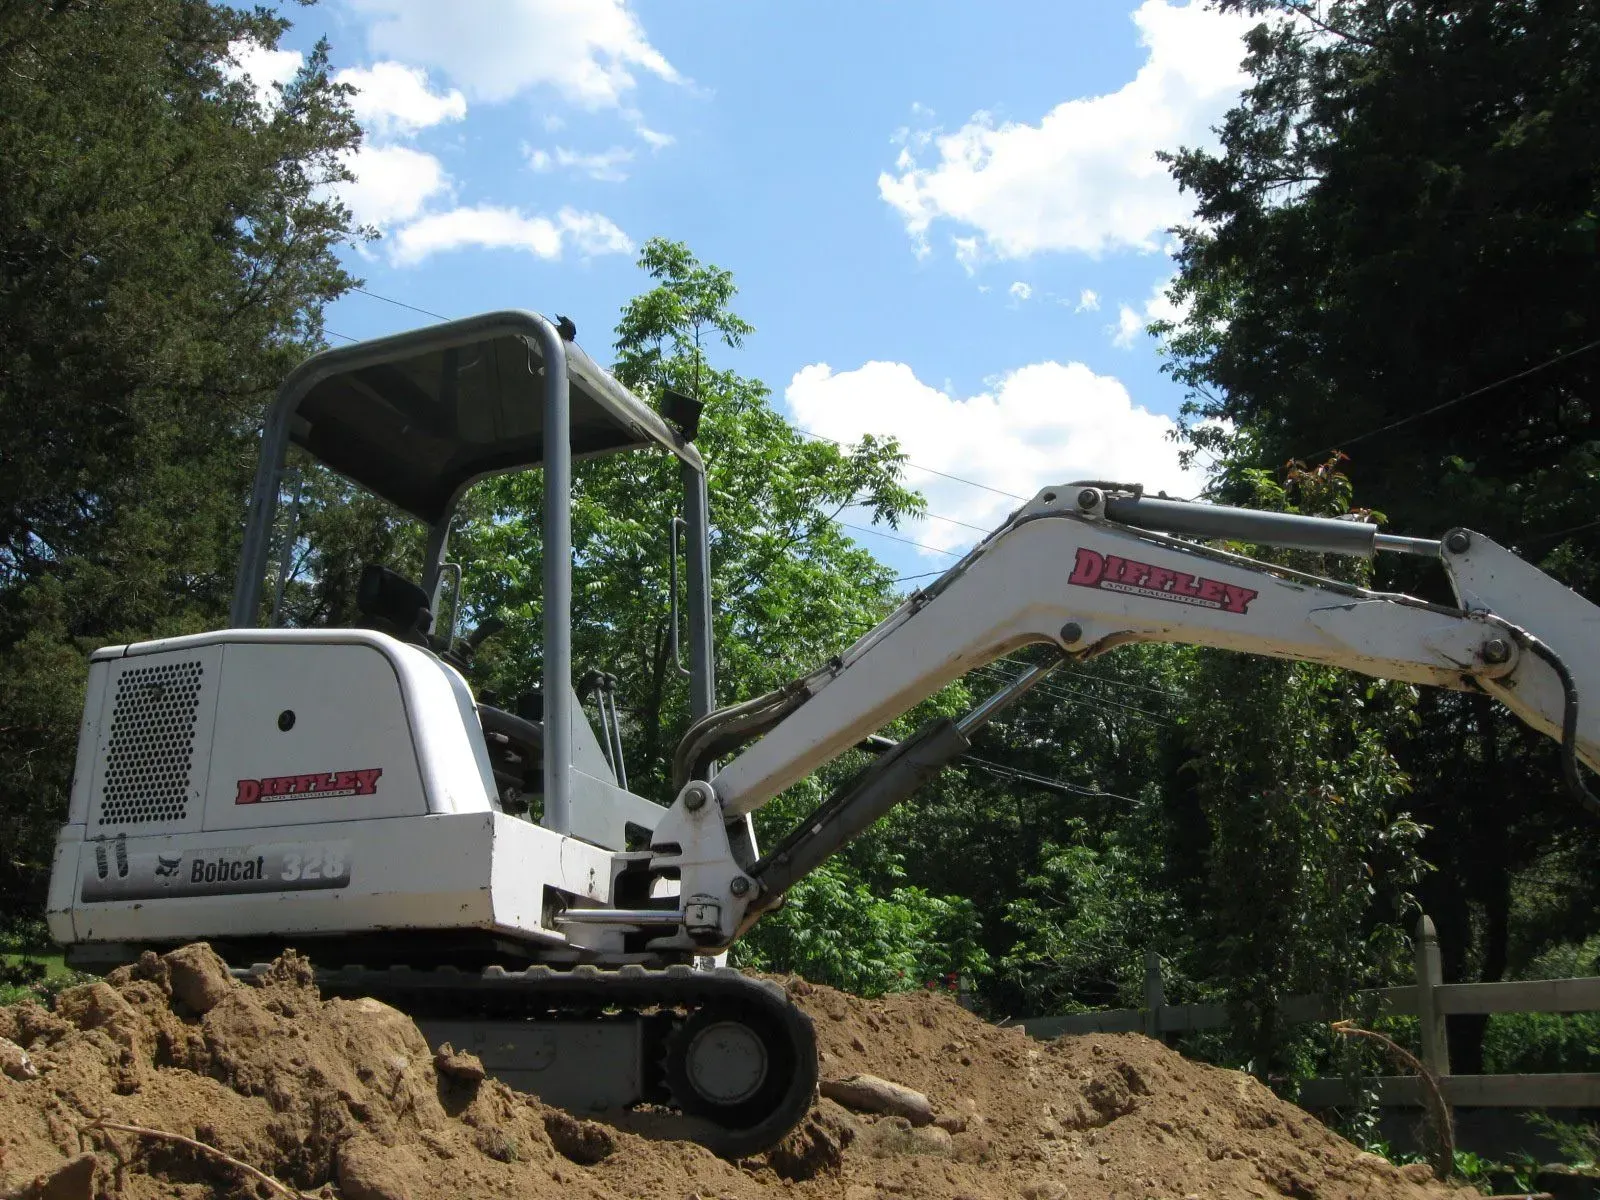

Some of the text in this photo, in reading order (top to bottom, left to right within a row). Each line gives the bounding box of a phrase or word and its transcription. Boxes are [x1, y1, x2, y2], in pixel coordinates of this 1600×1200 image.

[1067, 547, 1259, 615] DIFFLEY
[1104, 582, 1217, 607] AND DAUGHTERS
[235, 768, 383, 805] DIFFLEY
[190, 852, 345, 884] Bobcat 328
